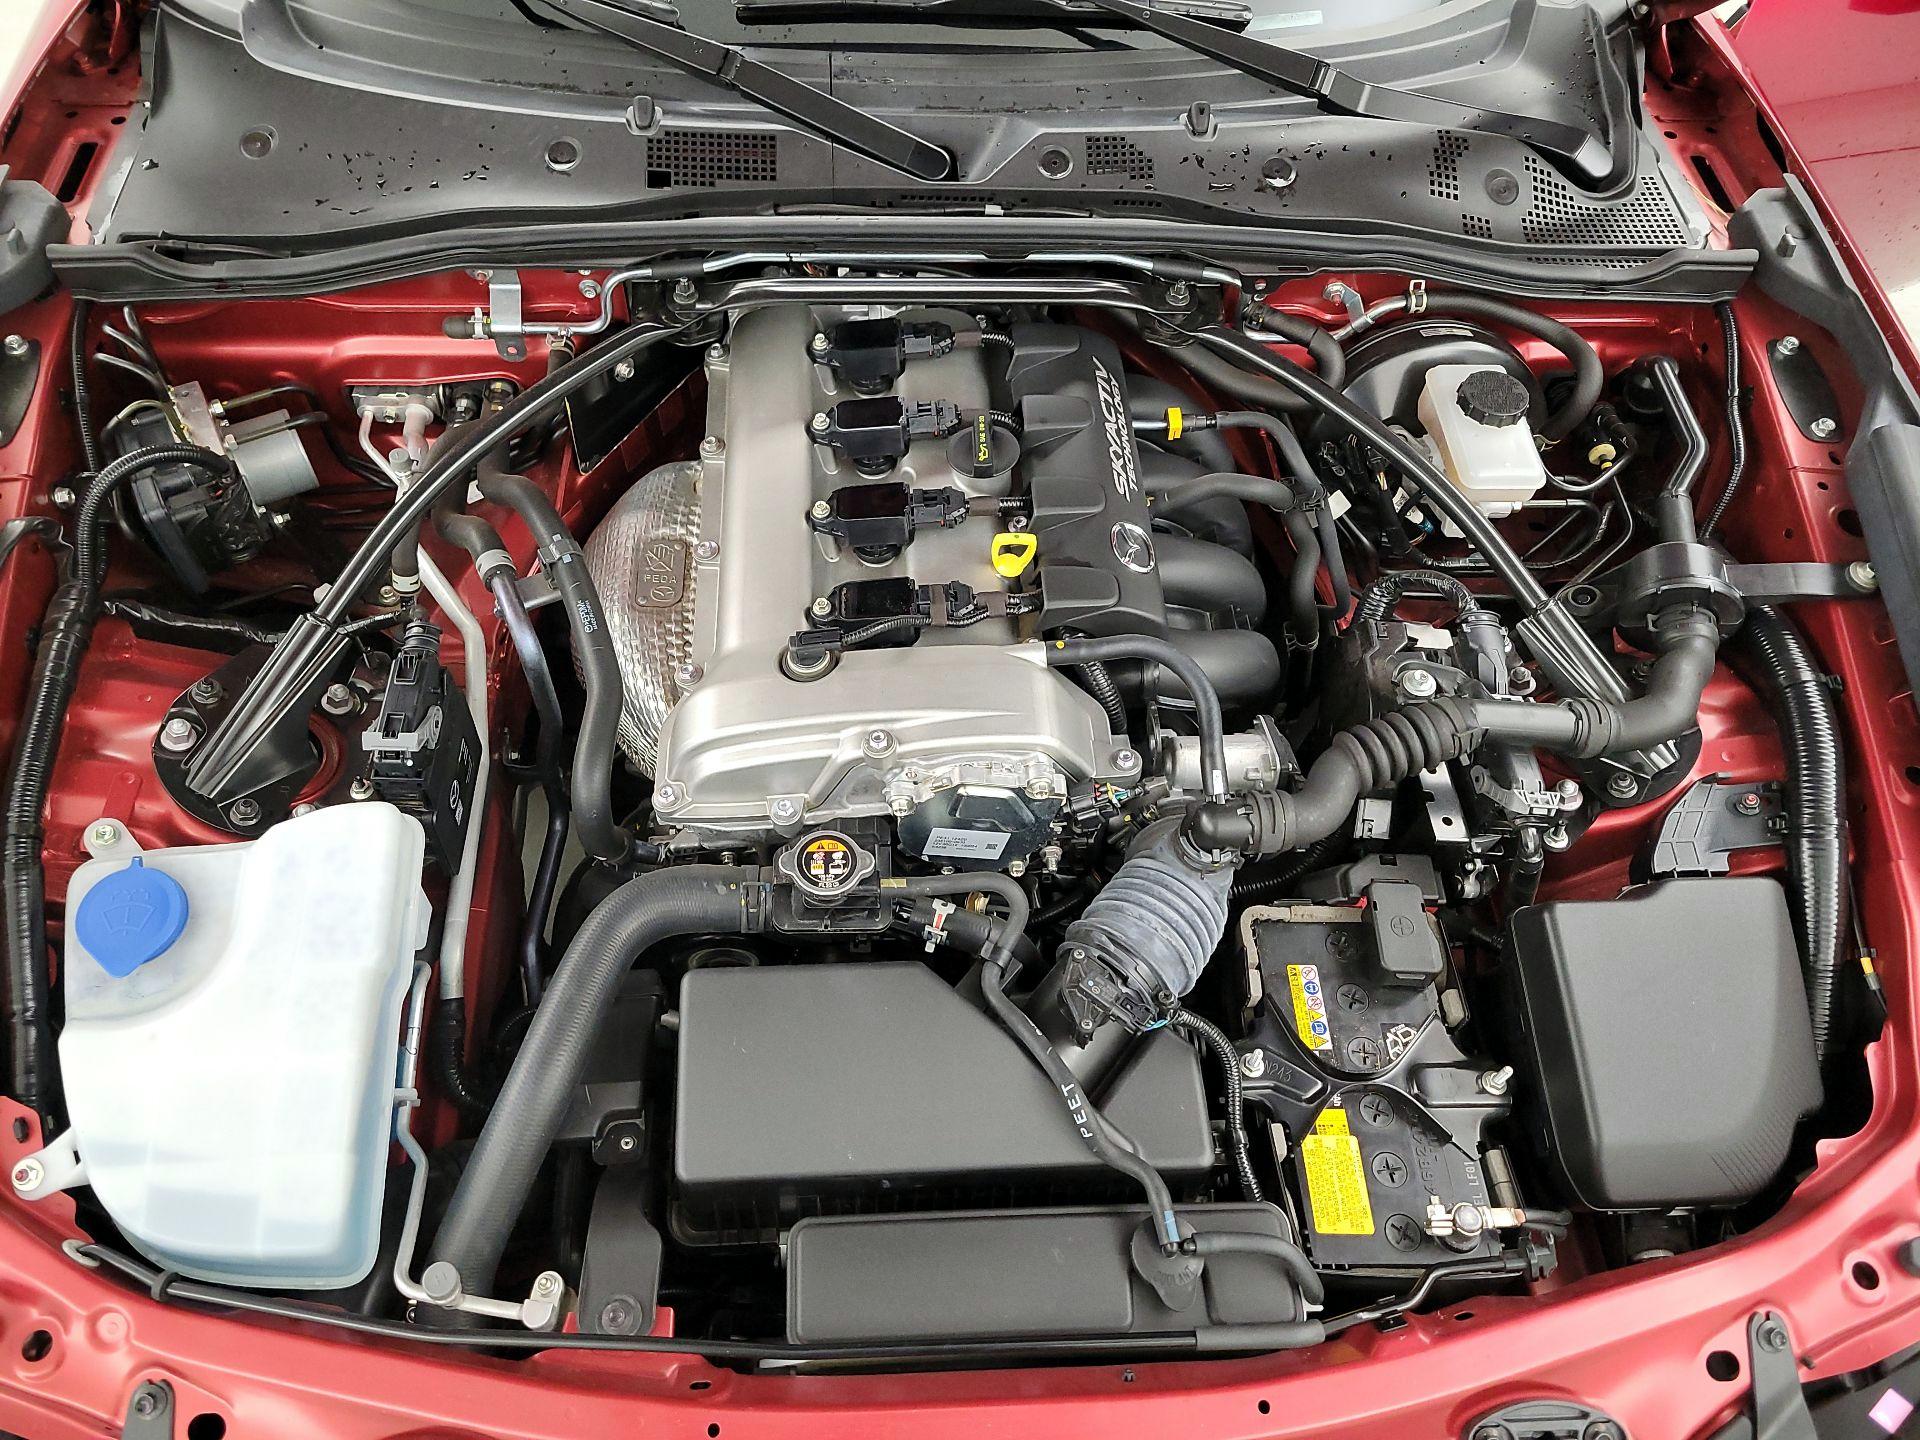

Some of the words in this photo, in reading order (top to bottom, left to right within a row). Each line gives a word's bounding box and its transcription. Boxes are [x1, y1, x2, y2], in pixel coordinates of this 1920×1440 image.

[1092, 356, 1130, 502] SKYACTIV
[1108, 373, 1138, 492] TECHNOLOGY
[1061, 1083, 1093, 1138] PEET
